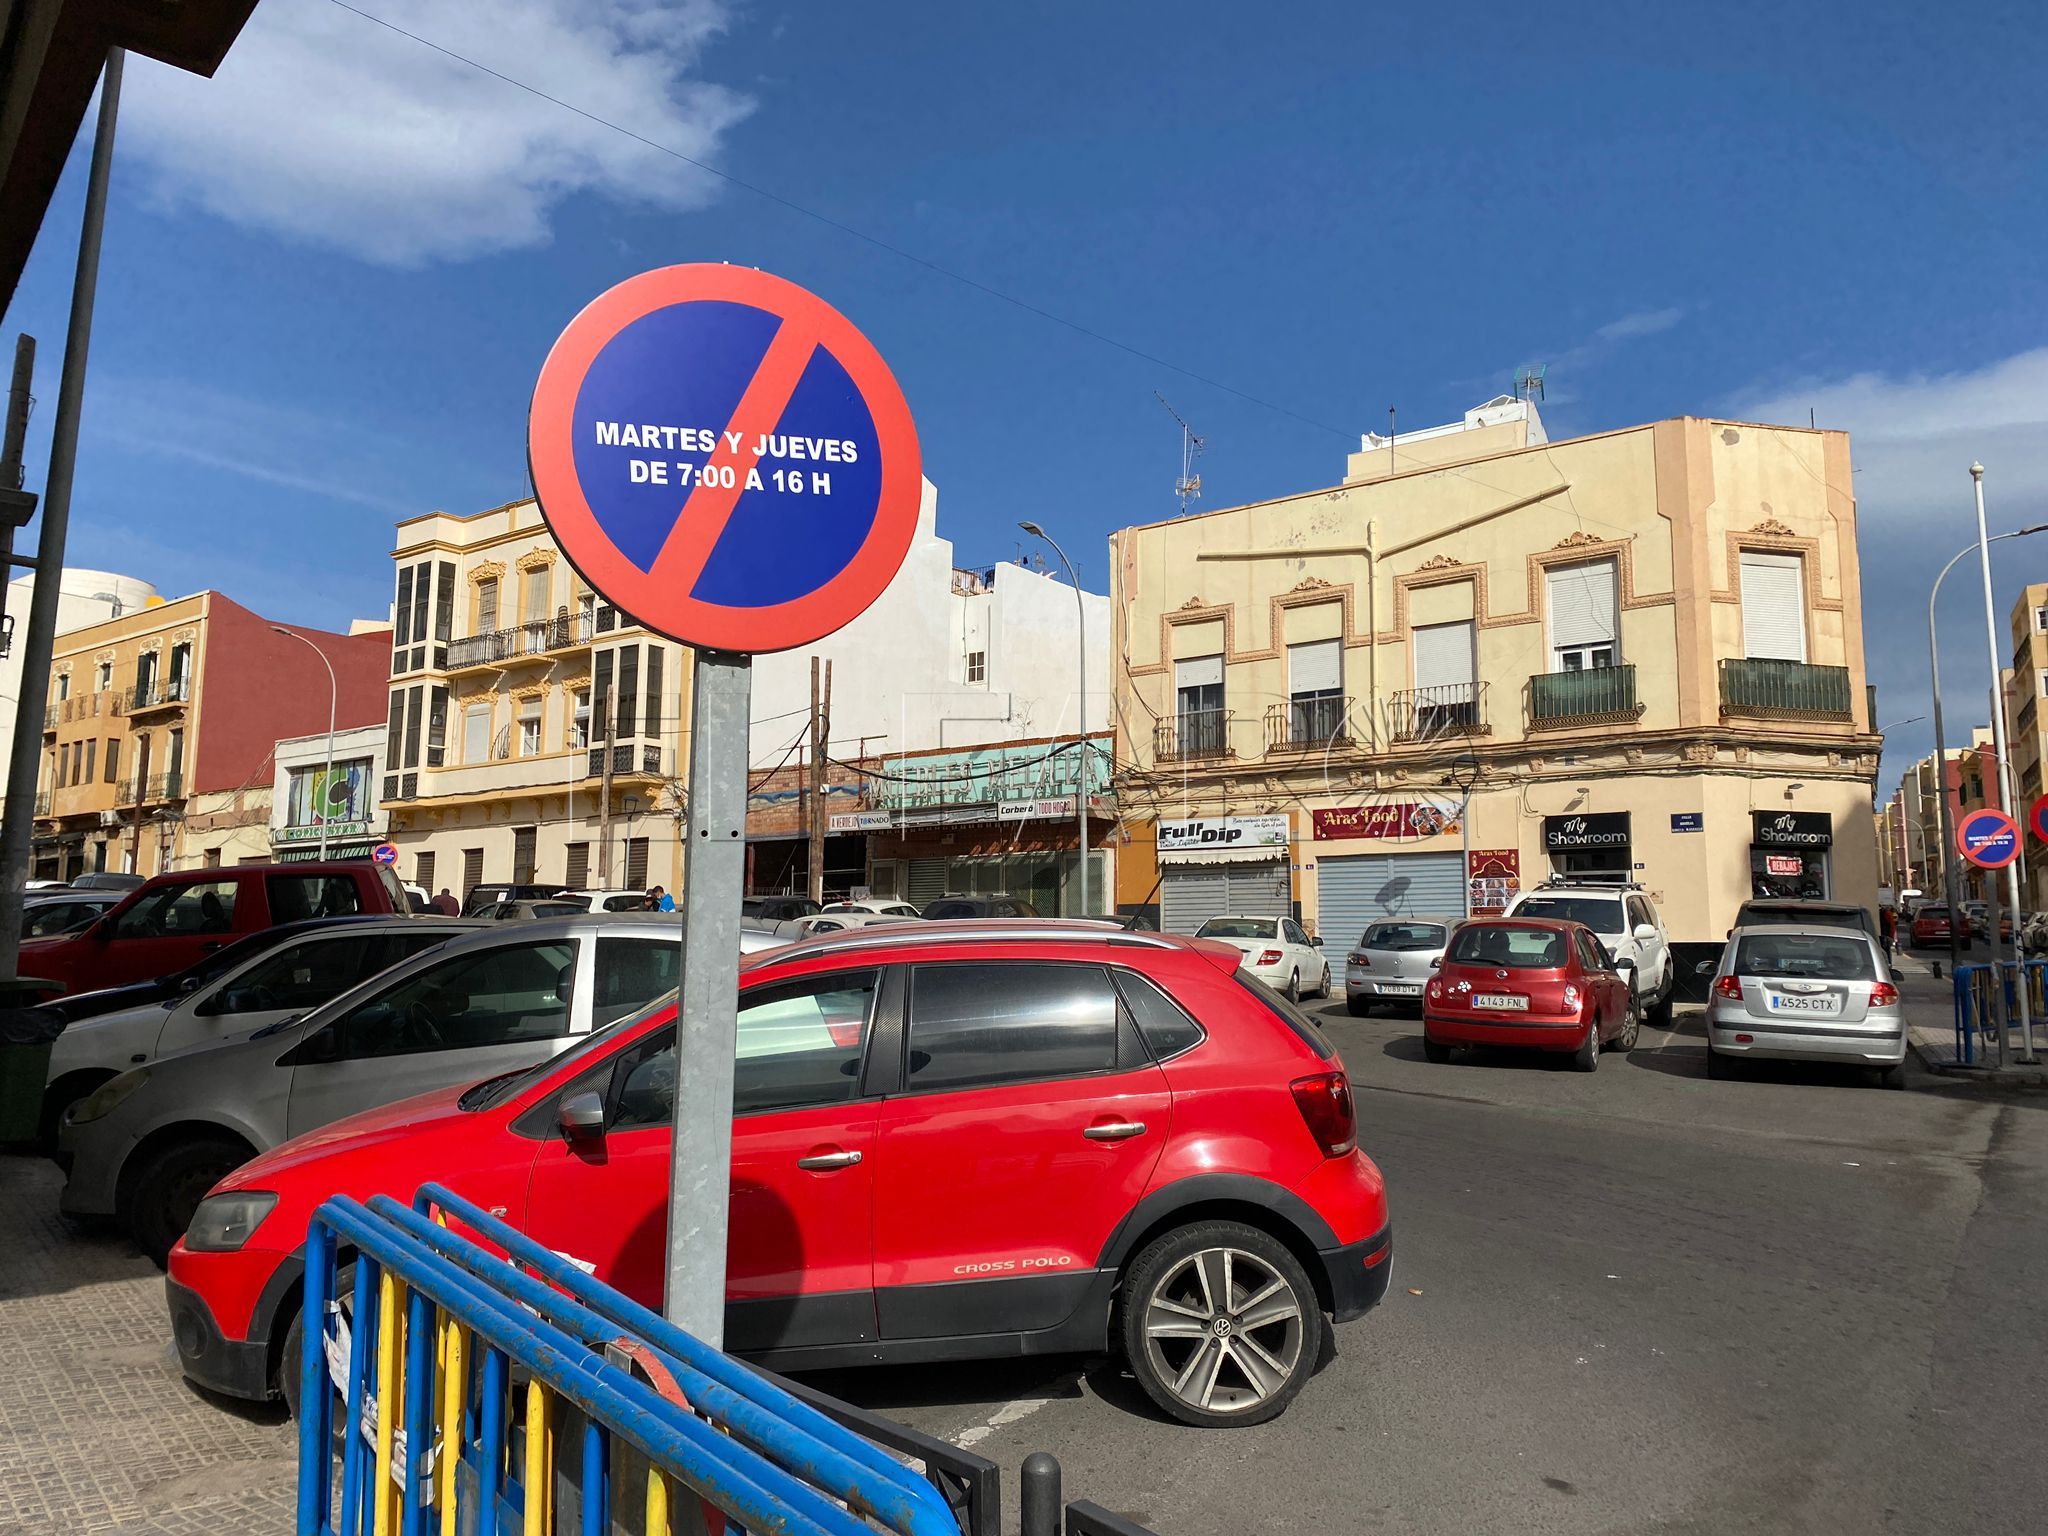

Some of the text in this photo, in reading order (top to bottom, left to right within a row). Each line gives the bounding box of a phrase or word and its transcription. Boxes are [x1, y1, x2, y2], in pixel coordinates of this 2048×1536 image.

[595, 421, 858, 464] MARTES Y JUEVES
[629, 459, 832, 495] DE 7:00 A 16 H
[1322, 806, 1399, 827] Aras Food
[1563, 816, 1588, 834] My
[1774, 813, 1797, 832] My
[1158, 822, 1242, 844] Full Dip
[1548, 831, 1627, 846] Showroom
[1760, 827, 1831, 843] Showroom
[1480, 996, 1525, 1008] 4143 FNL
[1781, 997, 1833, 1010] 4525 CTX
[953, 1255, 1072, 1275] CROSS POLO
